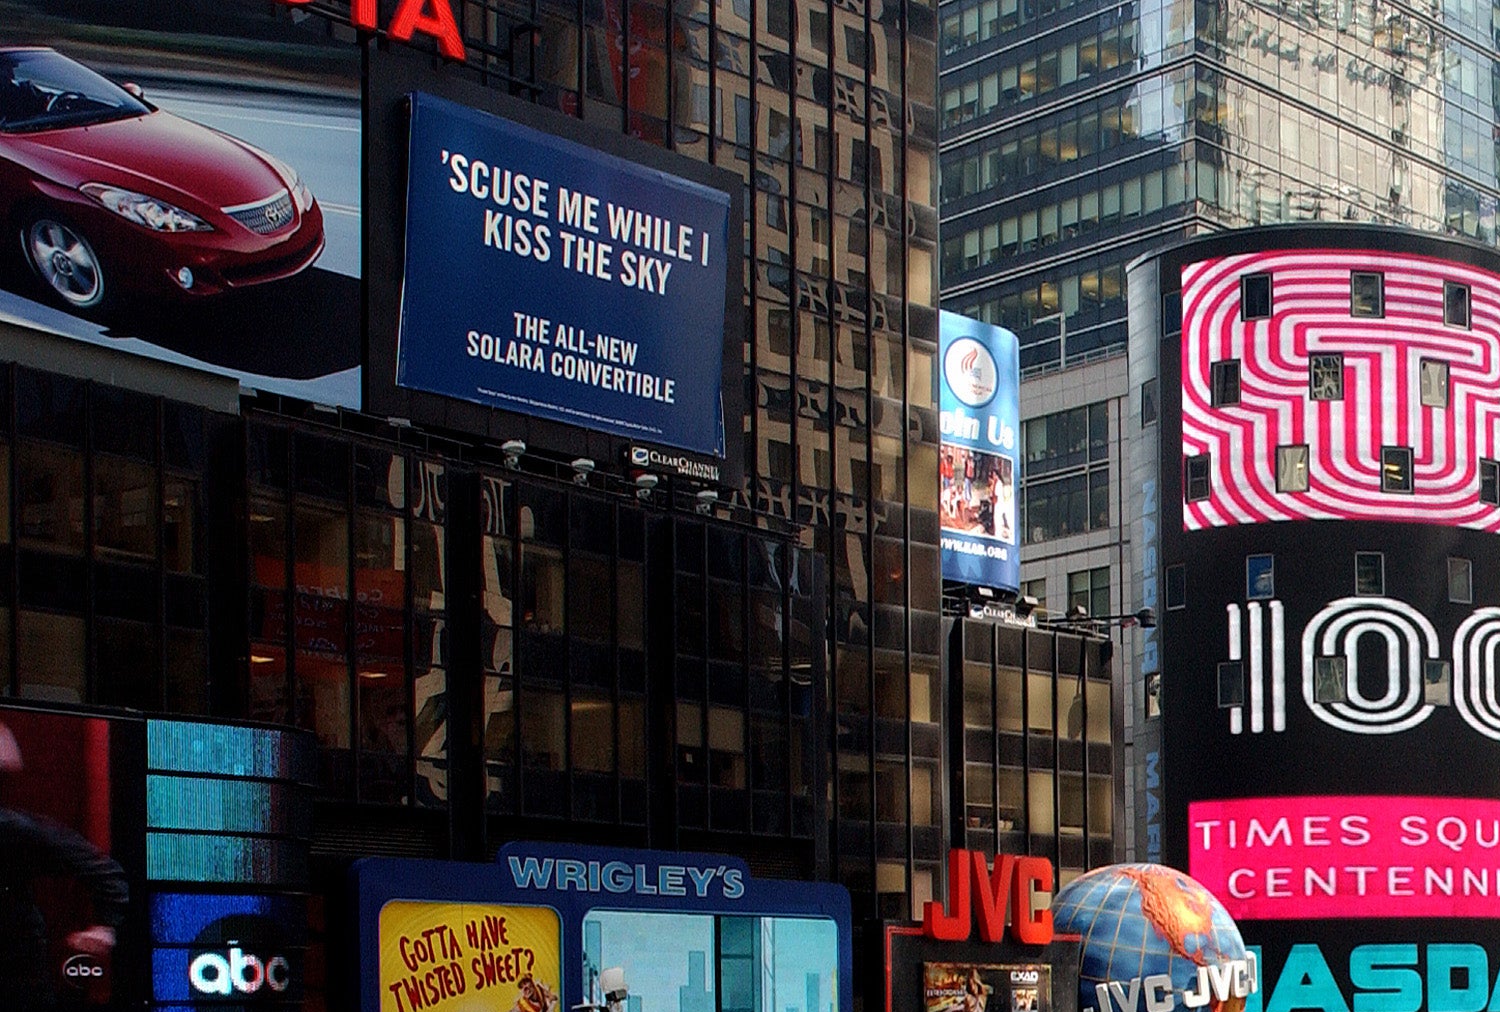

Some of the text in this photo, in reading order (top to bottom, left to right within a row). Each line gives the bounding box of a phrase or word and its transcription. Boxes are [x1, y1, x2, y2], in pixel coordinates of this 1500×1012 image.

[440, 148, 710, 267] 'SCUSE ME WHILE I
[484, 209, 673, 296] KISS THE SKY
[513, 311, 639, 368] THE ALL-NEW
[466, 331, 676, 404] SOLARA CONVERTIBLE
[939, 406, 1015, 450] oin Us
[1195, 814, 1372, 851] TIMES
[507, 855, 745, 900] WRIGLEY'S
[922, 848, 1055, 946] JVC
[66, 963, 104, 977] abc
[188, 940, 290, 995] abc
[399, 914, 511, 973] GOTTA HAVE
[471, 947, 536, 990] SWEET?
[1182, 957, 1251, 1010] JVC
